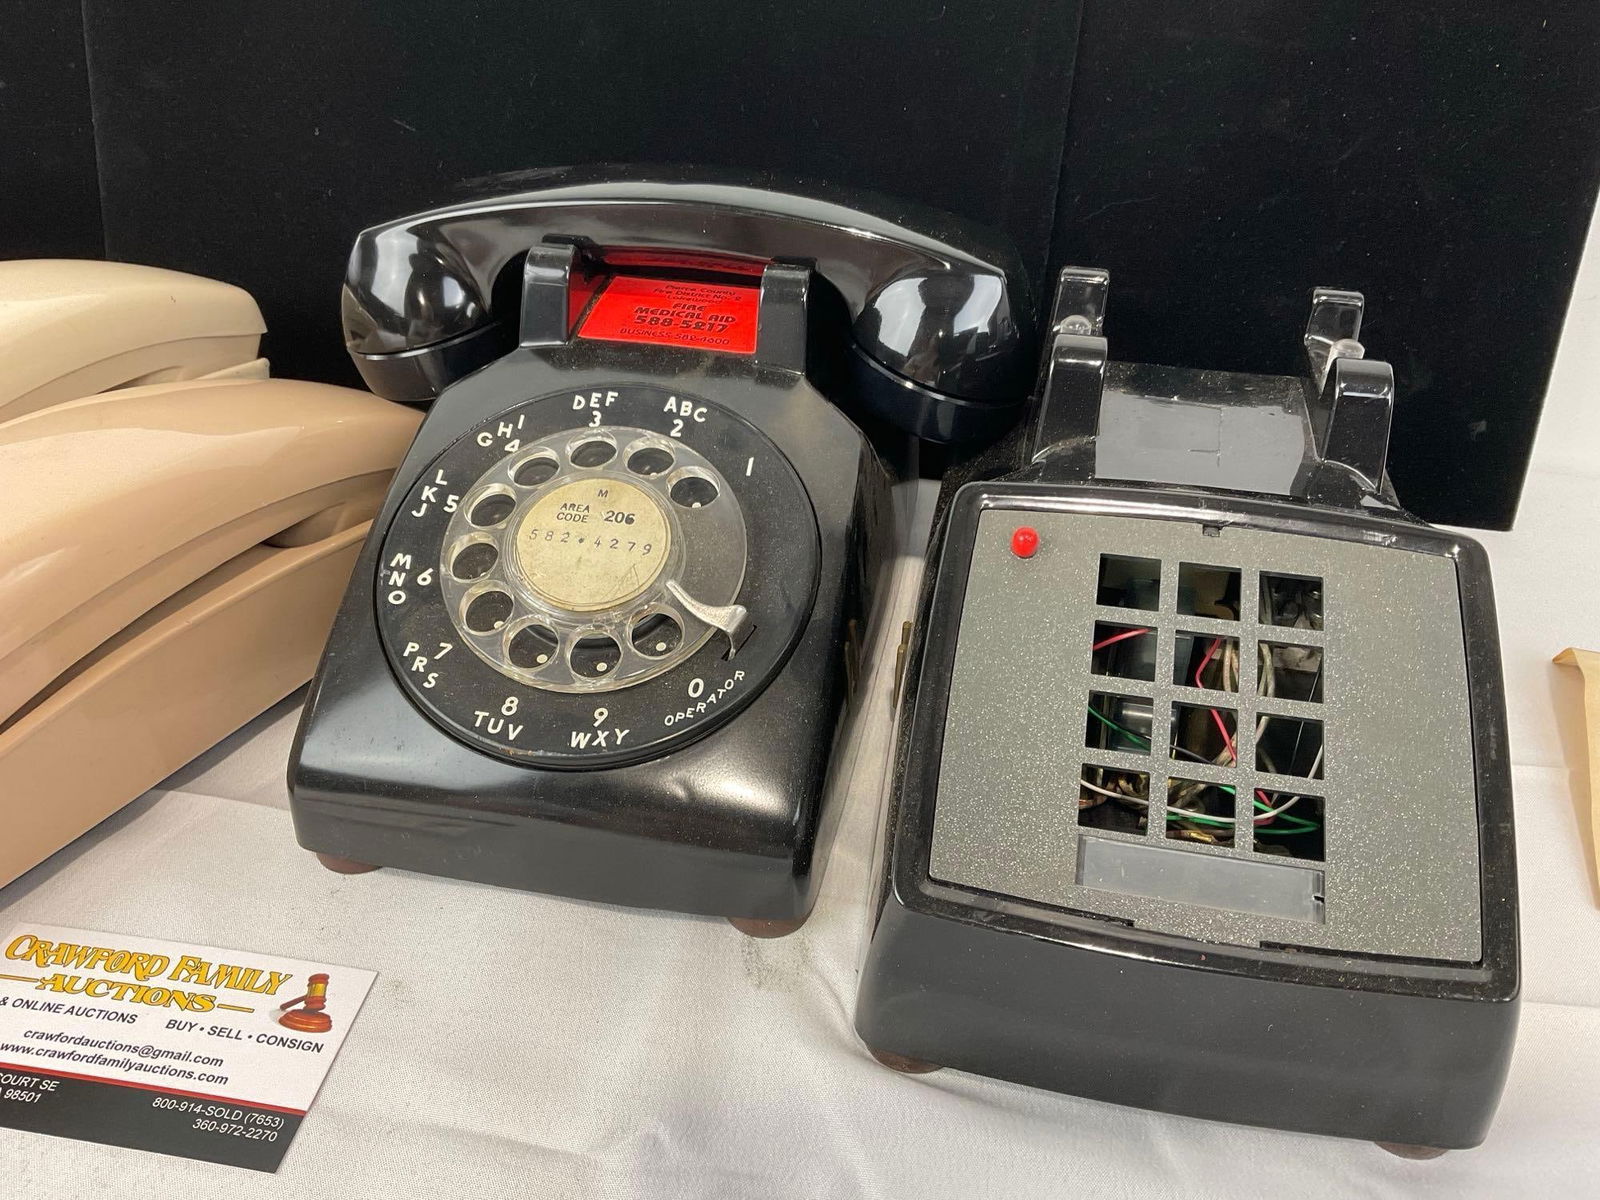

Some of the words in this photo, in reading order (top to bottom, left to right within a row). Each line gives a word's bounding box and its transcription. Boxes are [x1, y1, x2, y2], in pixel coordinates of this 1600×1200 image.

[634, 306, 704, 320] MEDICAL
[708, 314, 737, 324] AID
[672, 302, 708, 312] FIRE
[634, 315, 729, 333] 588-5217
[573, 390, 619, 411] DEF
[664, 396, 708, 424] ABC
[588, 411, 602, 428] 3
[669, 419, 685, 438] 2
[477, 414, 525, 447] GHI
[504, 439, 521, 453] 4
[443, 494, 459, 513] 5
[597, 489, 609, 498] M
[556, 512, 589, 523] CODE
[559, 503, 591, 513] AREA
[604, 510, 636, 525] 206
[416, 567, 433, 586] 6
[433, 642, 453, 661] 7
[501, 696, 519, 716] 8
[664, 670, 745, 727] OPERATOR
[473, 710, 523, 742] TUV
[593, 707, 609, 728] 9
[567, 728, 630, 750] WXY
[4, 934, 170, 982] CRAWFORD
[167, 955, 294, 996] FAMILY
[35, 973, 217, 1013] AUCTIONS
[12, 997, 65, 1014] ONLINE
[64, 1004, 138, 1025] AUCTIONS
[165, 1018, 198, 1033] BUY
[207, 1024, 243, 1042] SELL
[255, 1032, 324, 1055] CONSIGN
[23, 1028, 224, 1067] crawfordauctions@gmail.com
[0, 1042, 229, 1086] www.crawfordfamilyauctions.com
[0, 1072, 40, 1088] OURT
[39, 1079, 60, 1092] SE
[3, 1088, 42, 1104] 98501
[151, 1096, 243, 1121] 800-914-SOLD
[244, 1109, 285, 1131] (7653)
[192, 1117, 279, 1143] 360-972-2270
